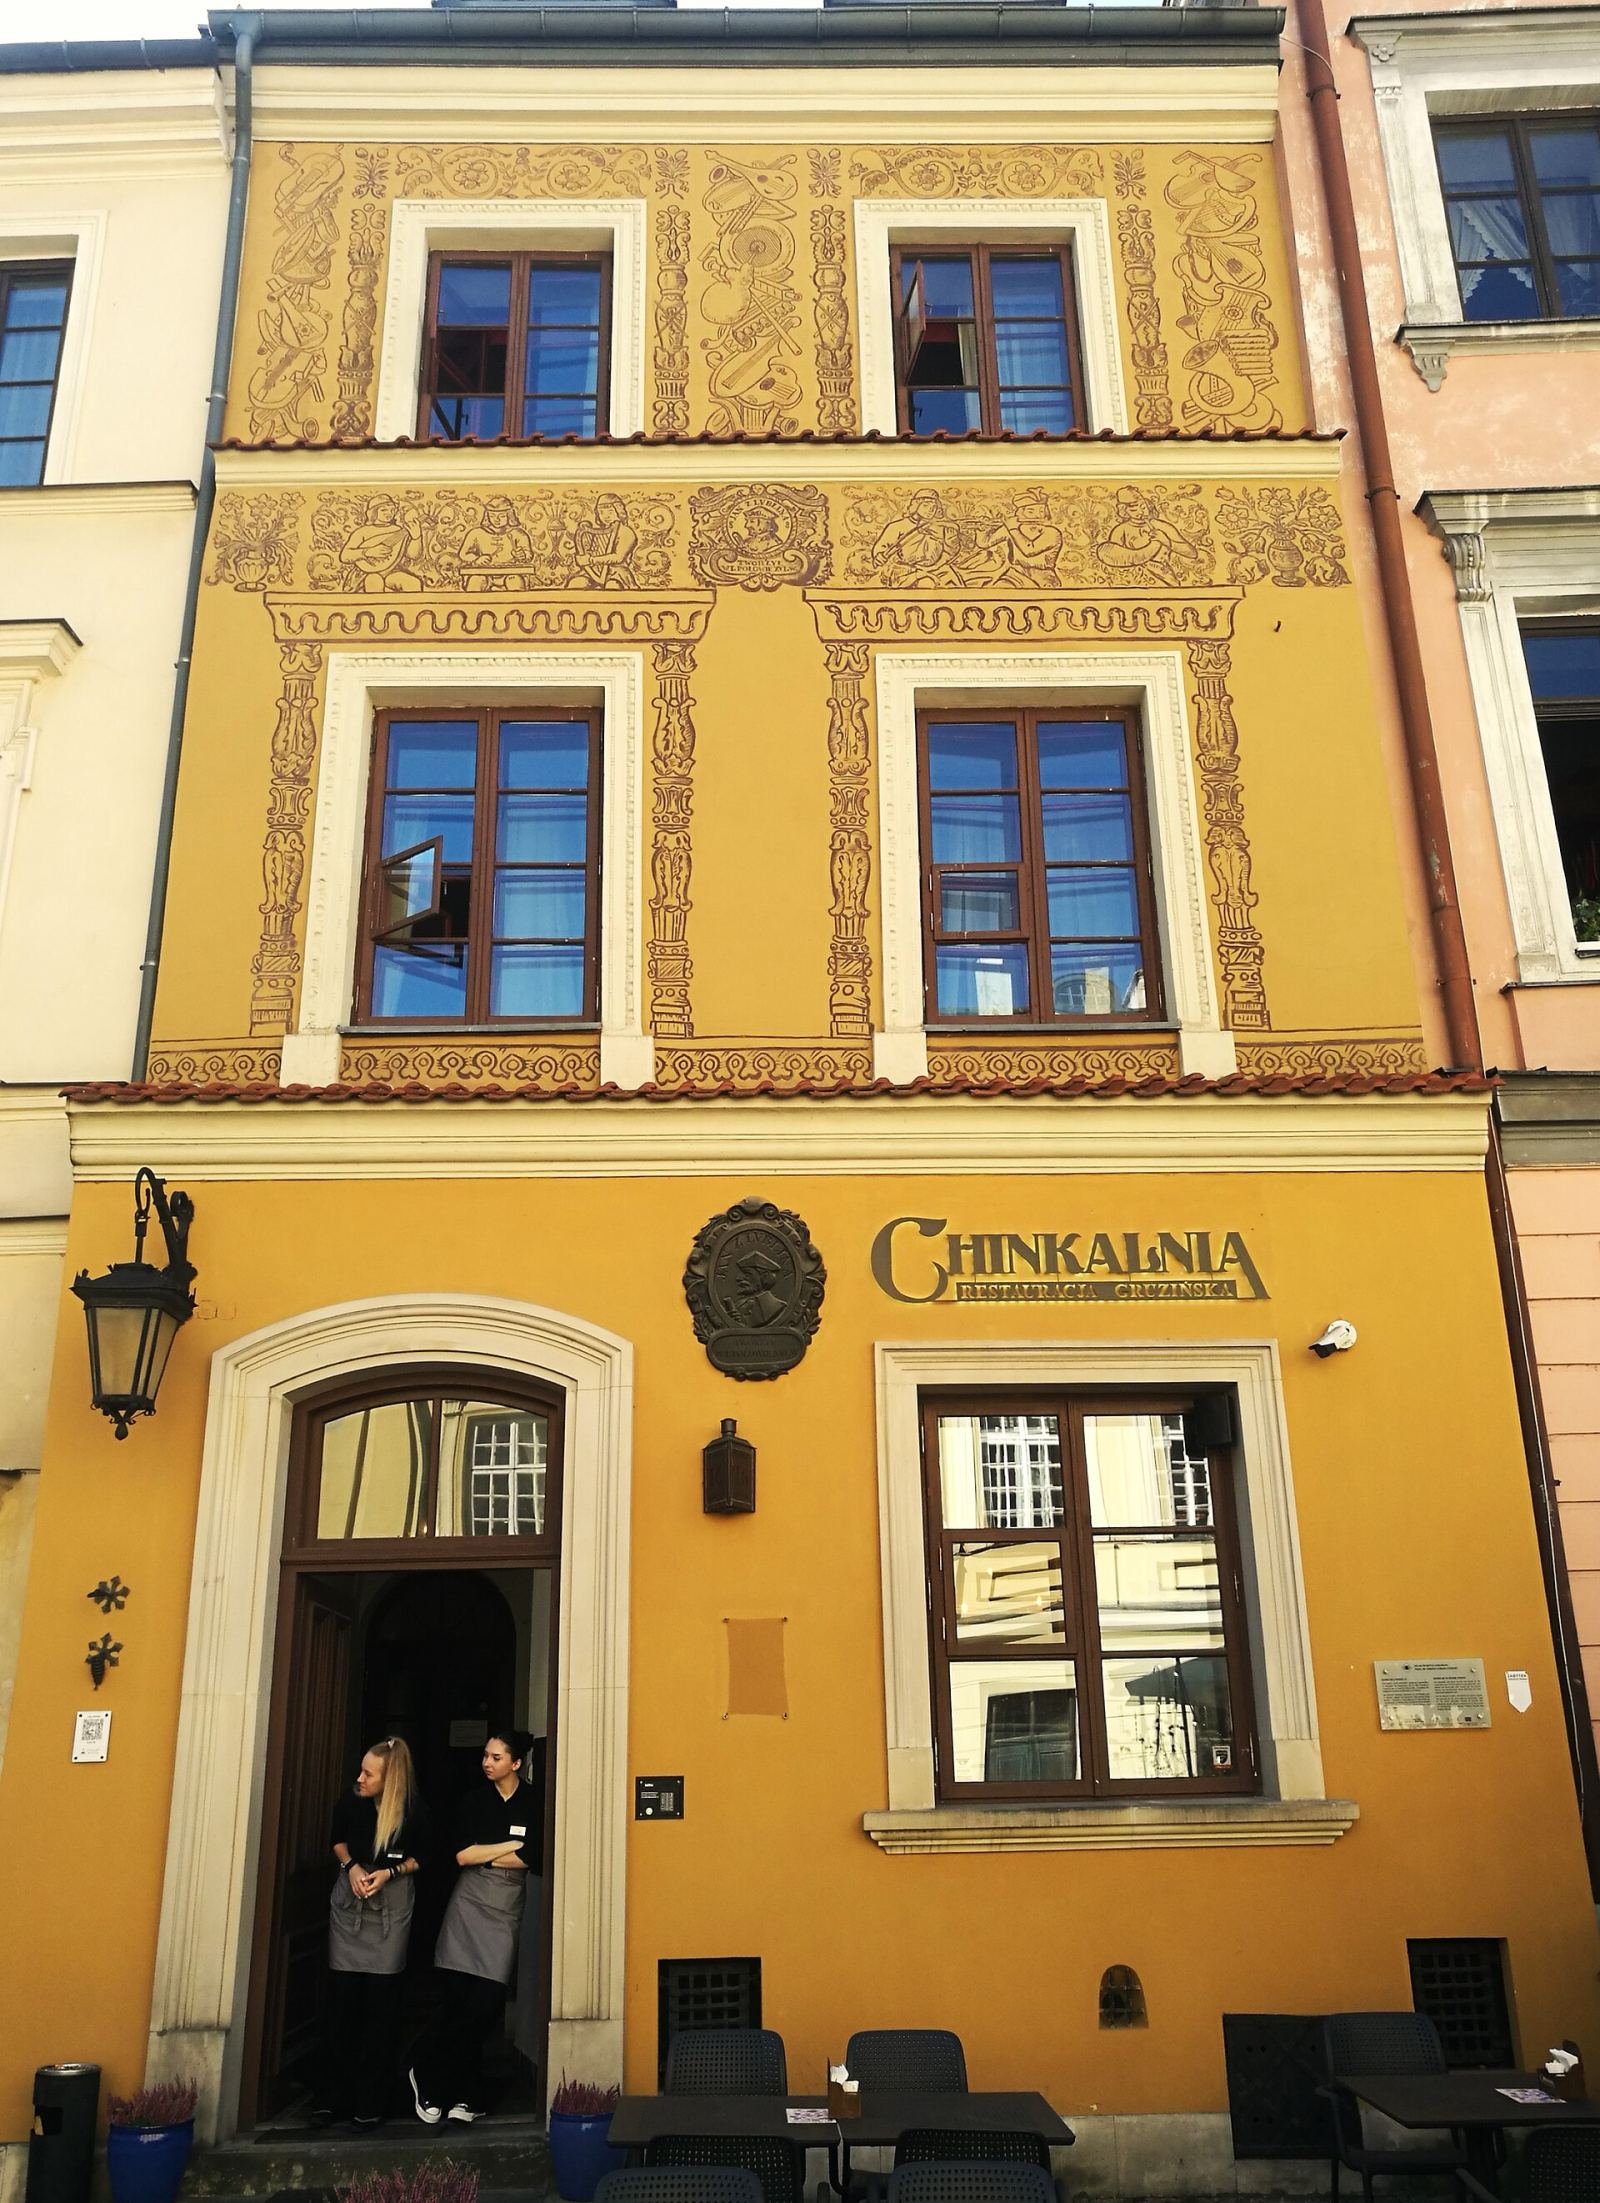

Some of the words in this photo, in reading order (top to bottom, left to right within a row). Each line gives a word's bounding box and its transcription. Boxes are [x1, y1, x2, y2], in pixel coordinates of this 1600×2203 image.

[729, 506, 744, 521] JAN
[870, 1216, 1272, 1304] CHINKALNIA
[959, 1283, 1098, 1300] RESTAURACJA
[1114, 1280, 1234, 1299] GRUZIŃSKA
